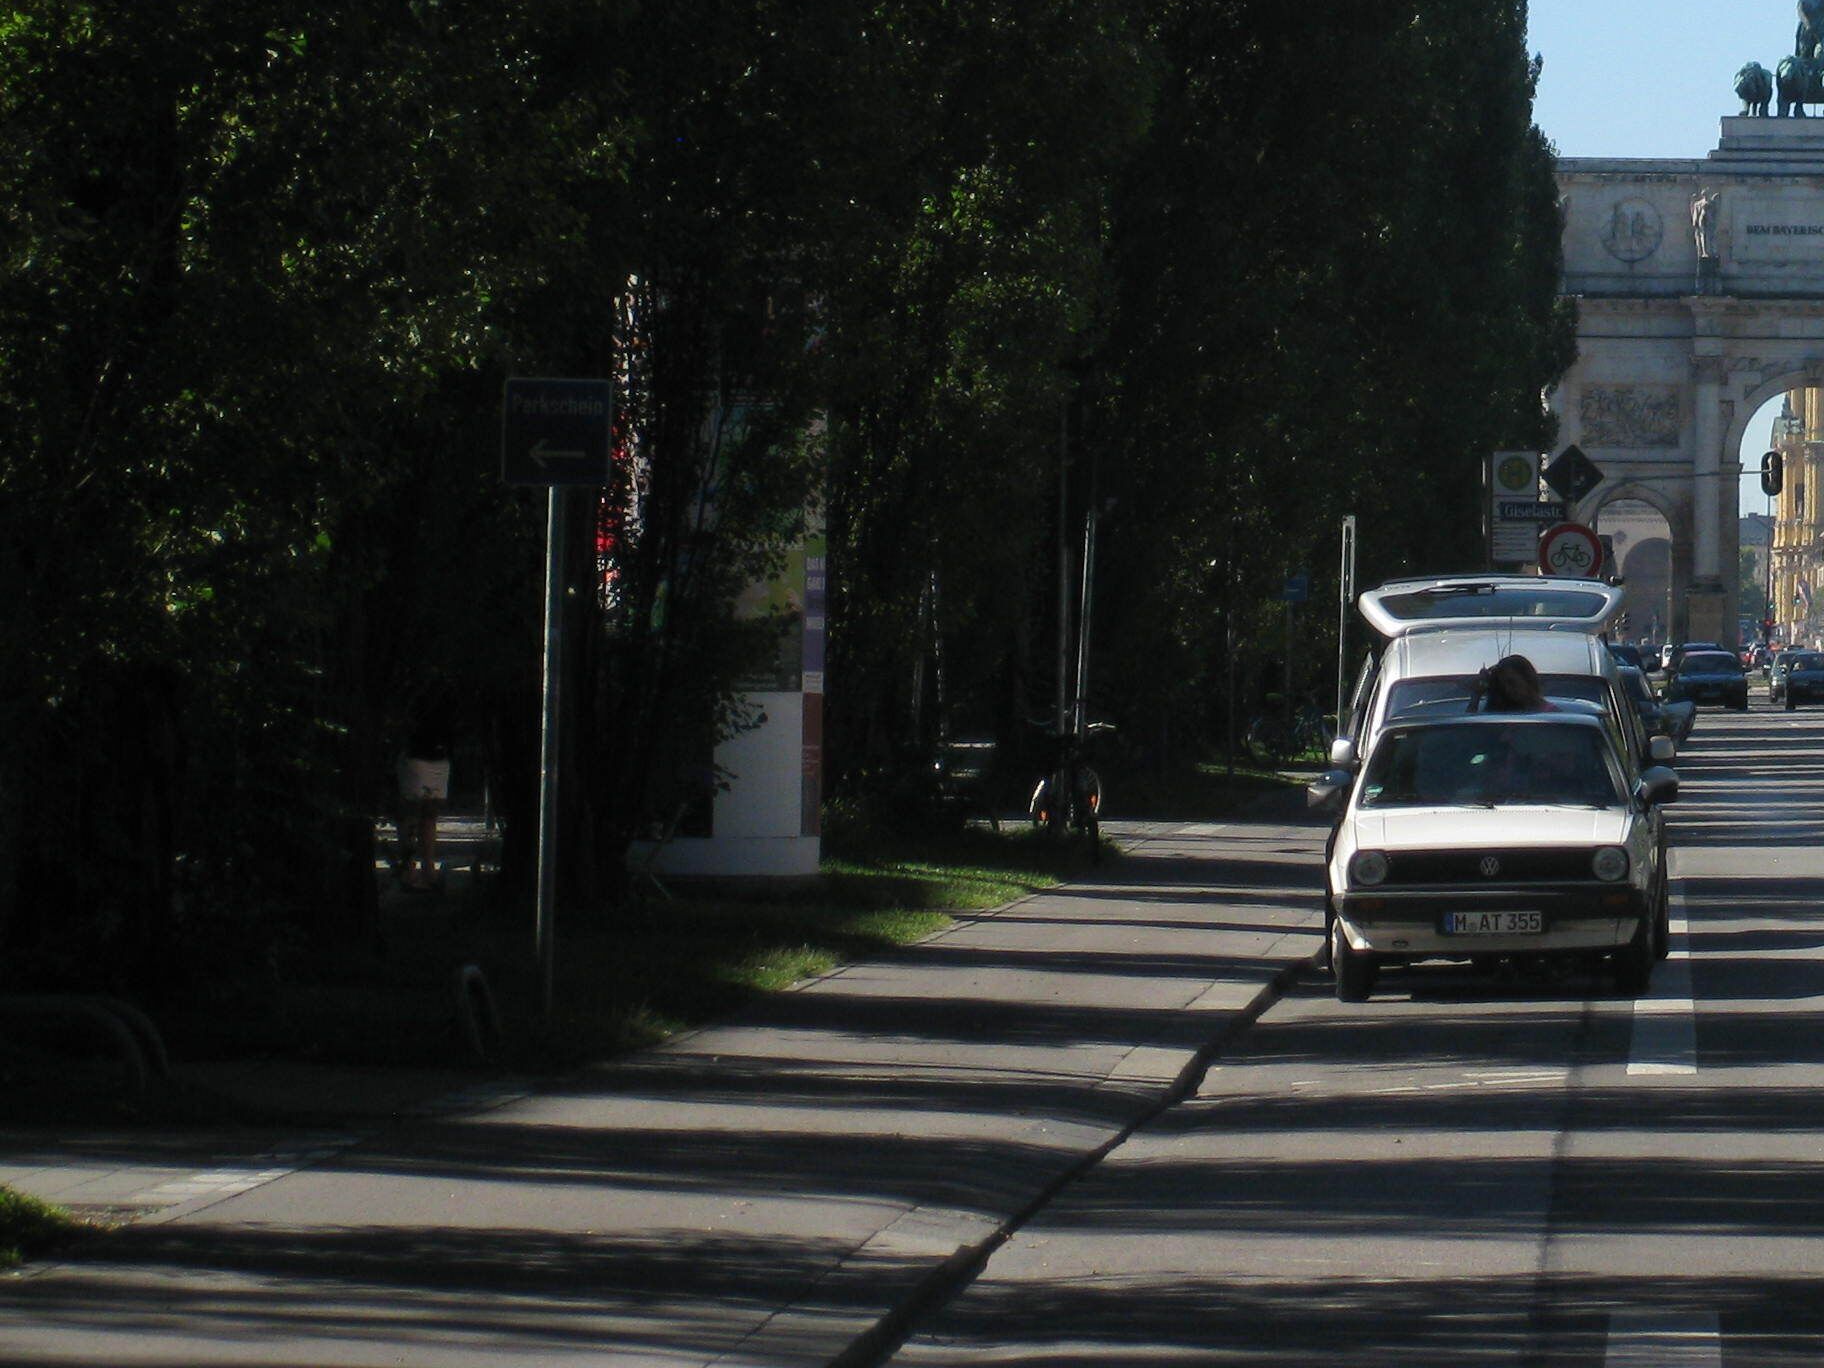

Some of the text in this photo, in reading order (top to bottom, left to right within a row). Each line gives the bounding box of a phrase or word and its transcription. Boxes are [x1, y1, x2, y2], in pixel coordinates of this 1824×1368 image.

[1745, 224, 1770, 235] DEM
[512, 393, 603, 416] Parkschein
[1455, 913, 1540, 931] M AT 355
